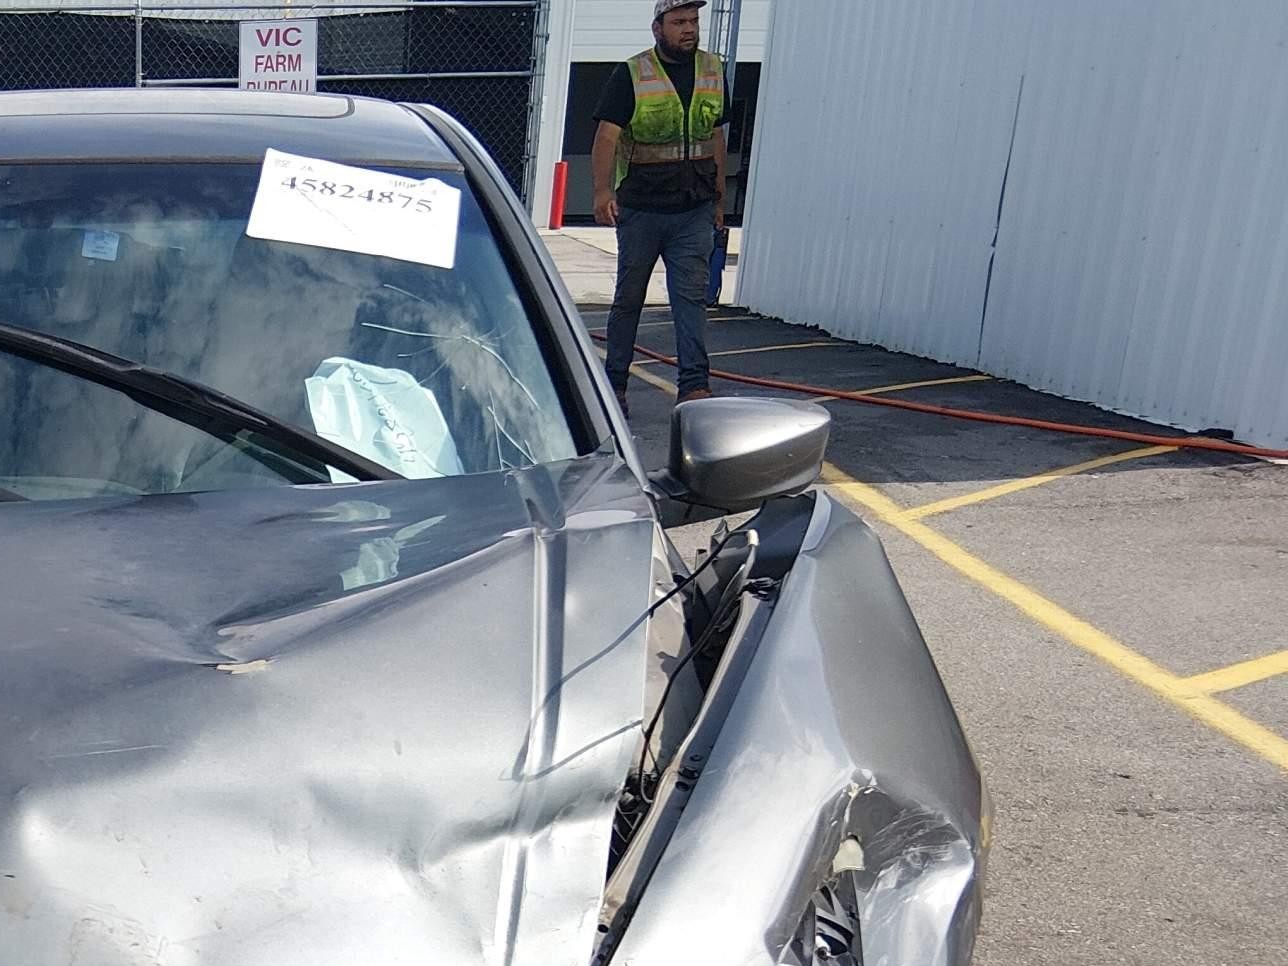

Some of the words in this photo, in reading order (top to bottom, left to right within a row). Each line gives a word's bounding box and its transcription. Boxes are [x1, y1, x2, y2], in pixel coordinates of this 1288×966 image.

[255, 27, 303, 47] VIC
[254, 53, 302, 73] FARM
[280, 175, 433, 213] 45824875
